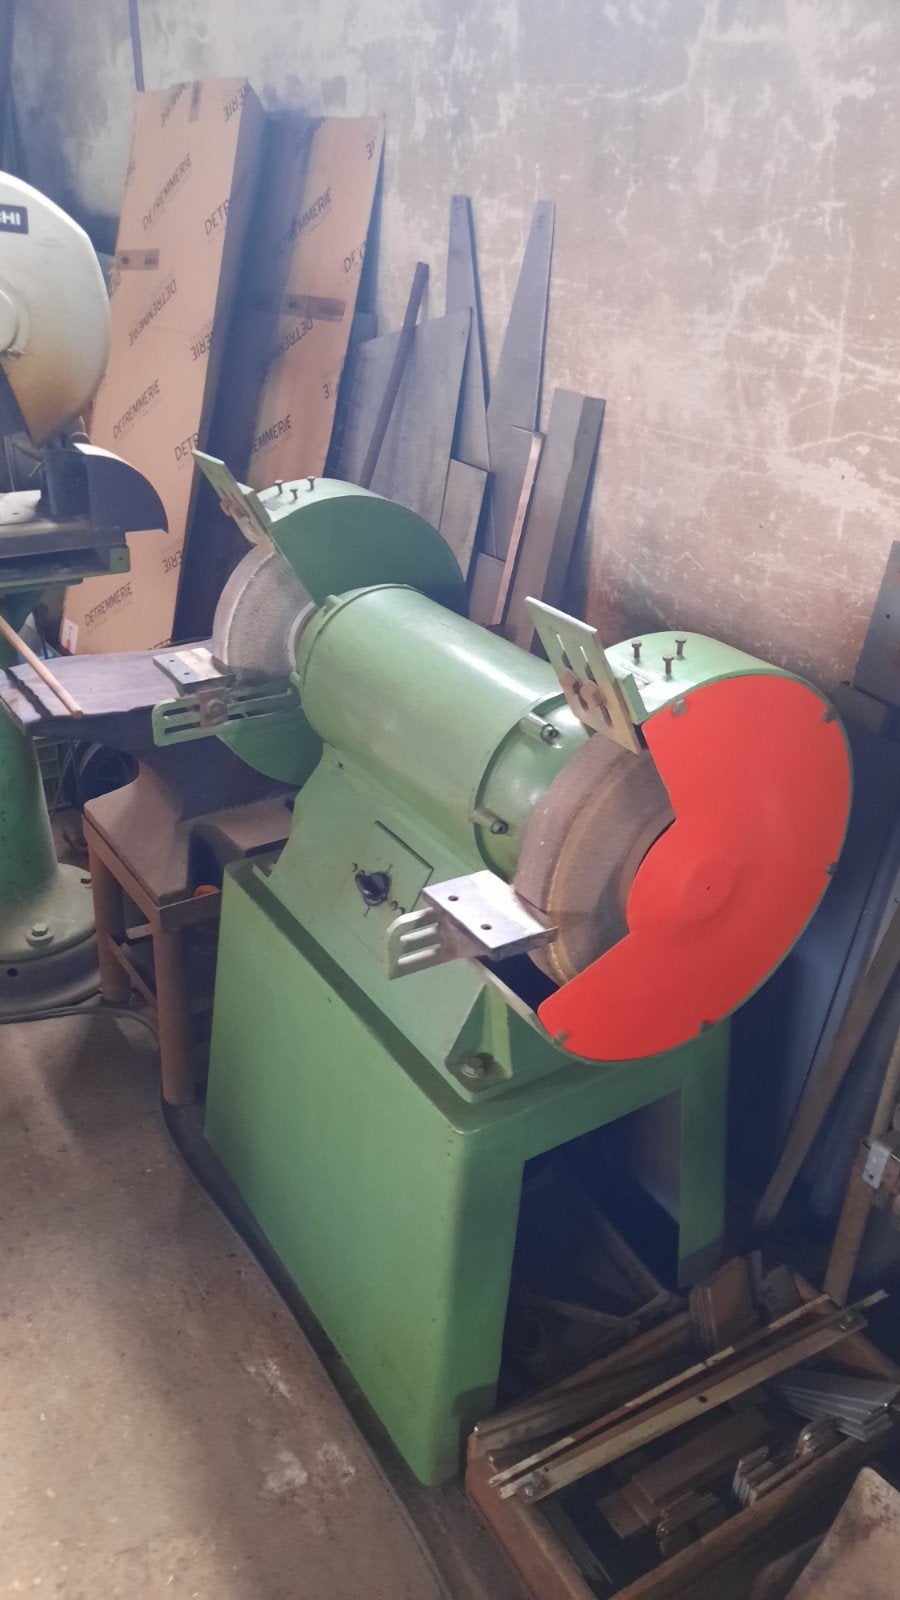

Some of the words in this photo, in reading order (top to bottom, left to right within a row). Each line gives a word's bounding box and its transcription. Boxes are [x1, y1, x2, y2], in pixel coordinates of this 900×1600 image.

[143, 152, 192, 230] DETREMMERIE
[113, 379, 160, 439] DETREMMERIE
[84, 581, 133, 627] DETREMMERIE
